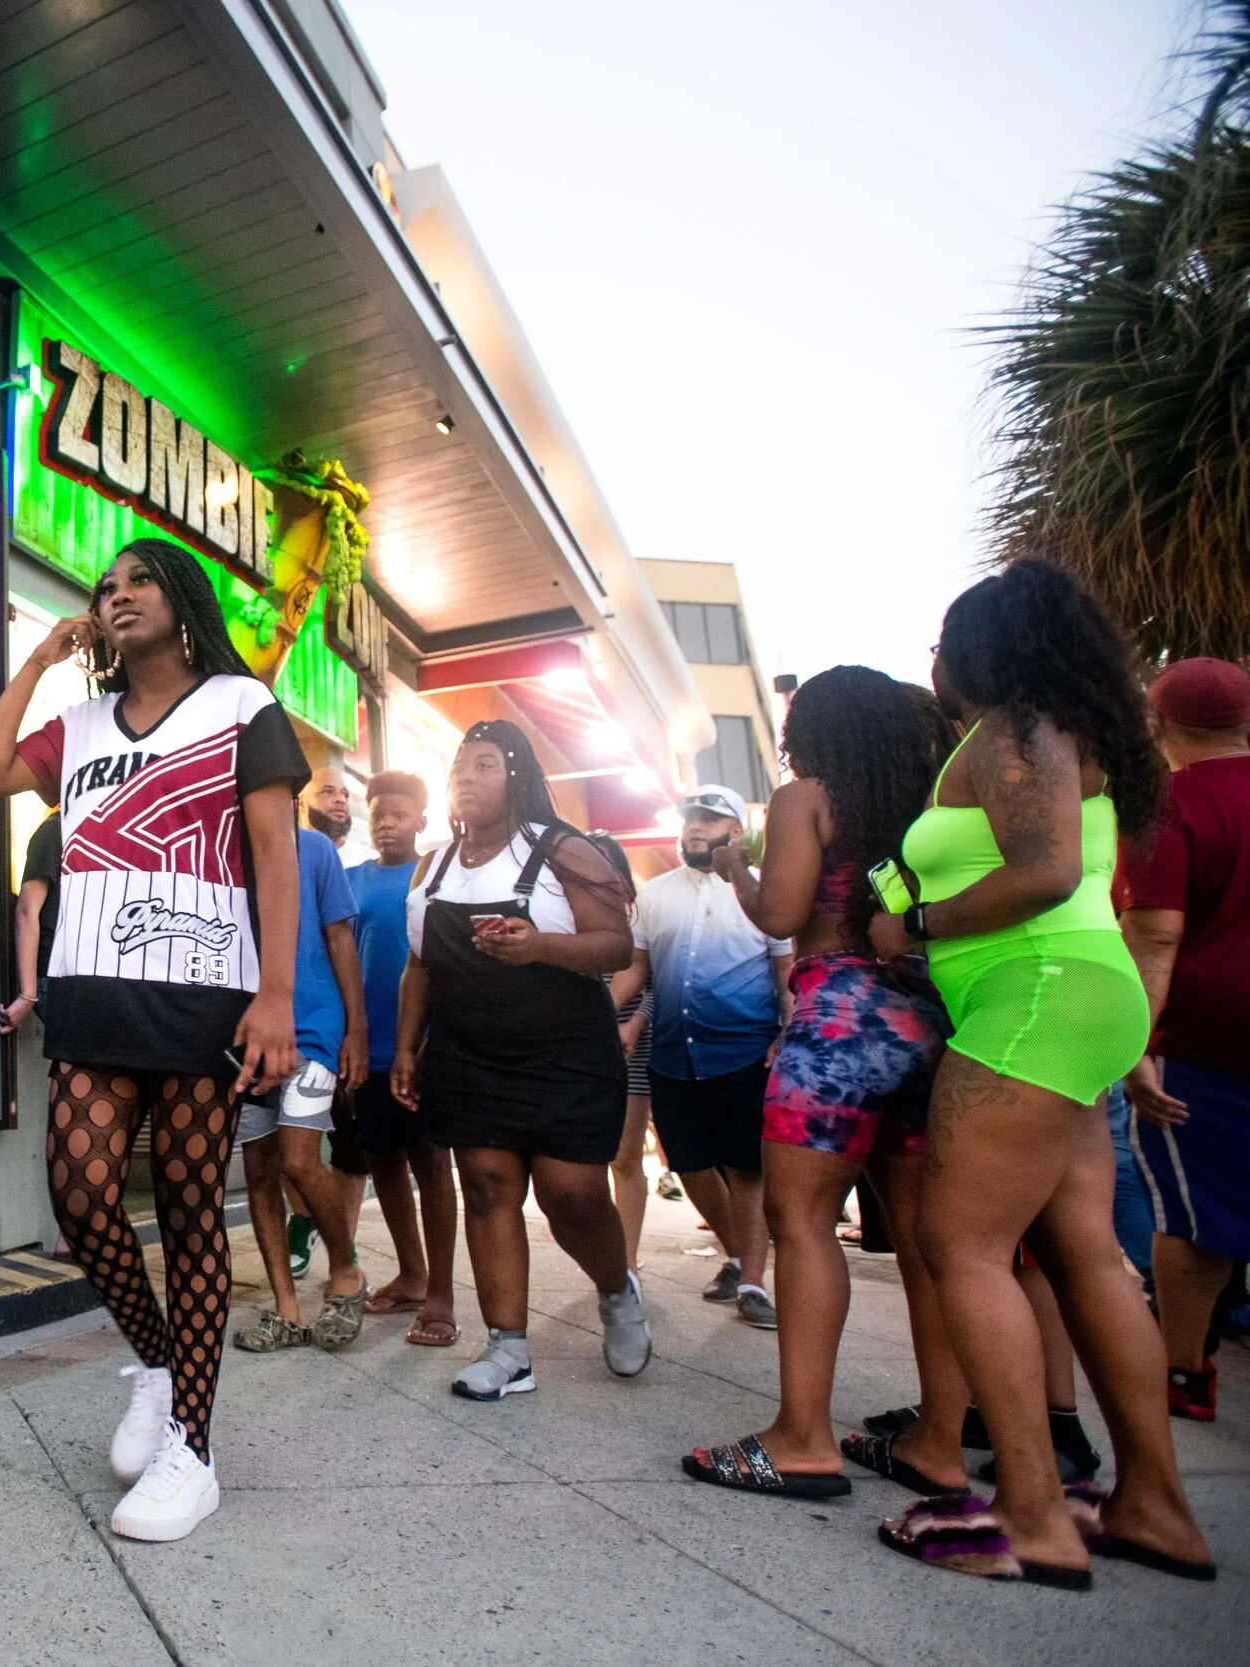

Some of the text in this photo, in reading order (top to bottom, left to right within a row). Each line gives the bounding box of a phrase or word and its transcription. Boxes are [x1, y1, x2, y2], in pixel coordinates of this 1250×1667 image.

[53, 340, 274, 588] ZOMBIE
[111, 897, 238, 955] Pyramid
[184, 951, 230, 986] 89
